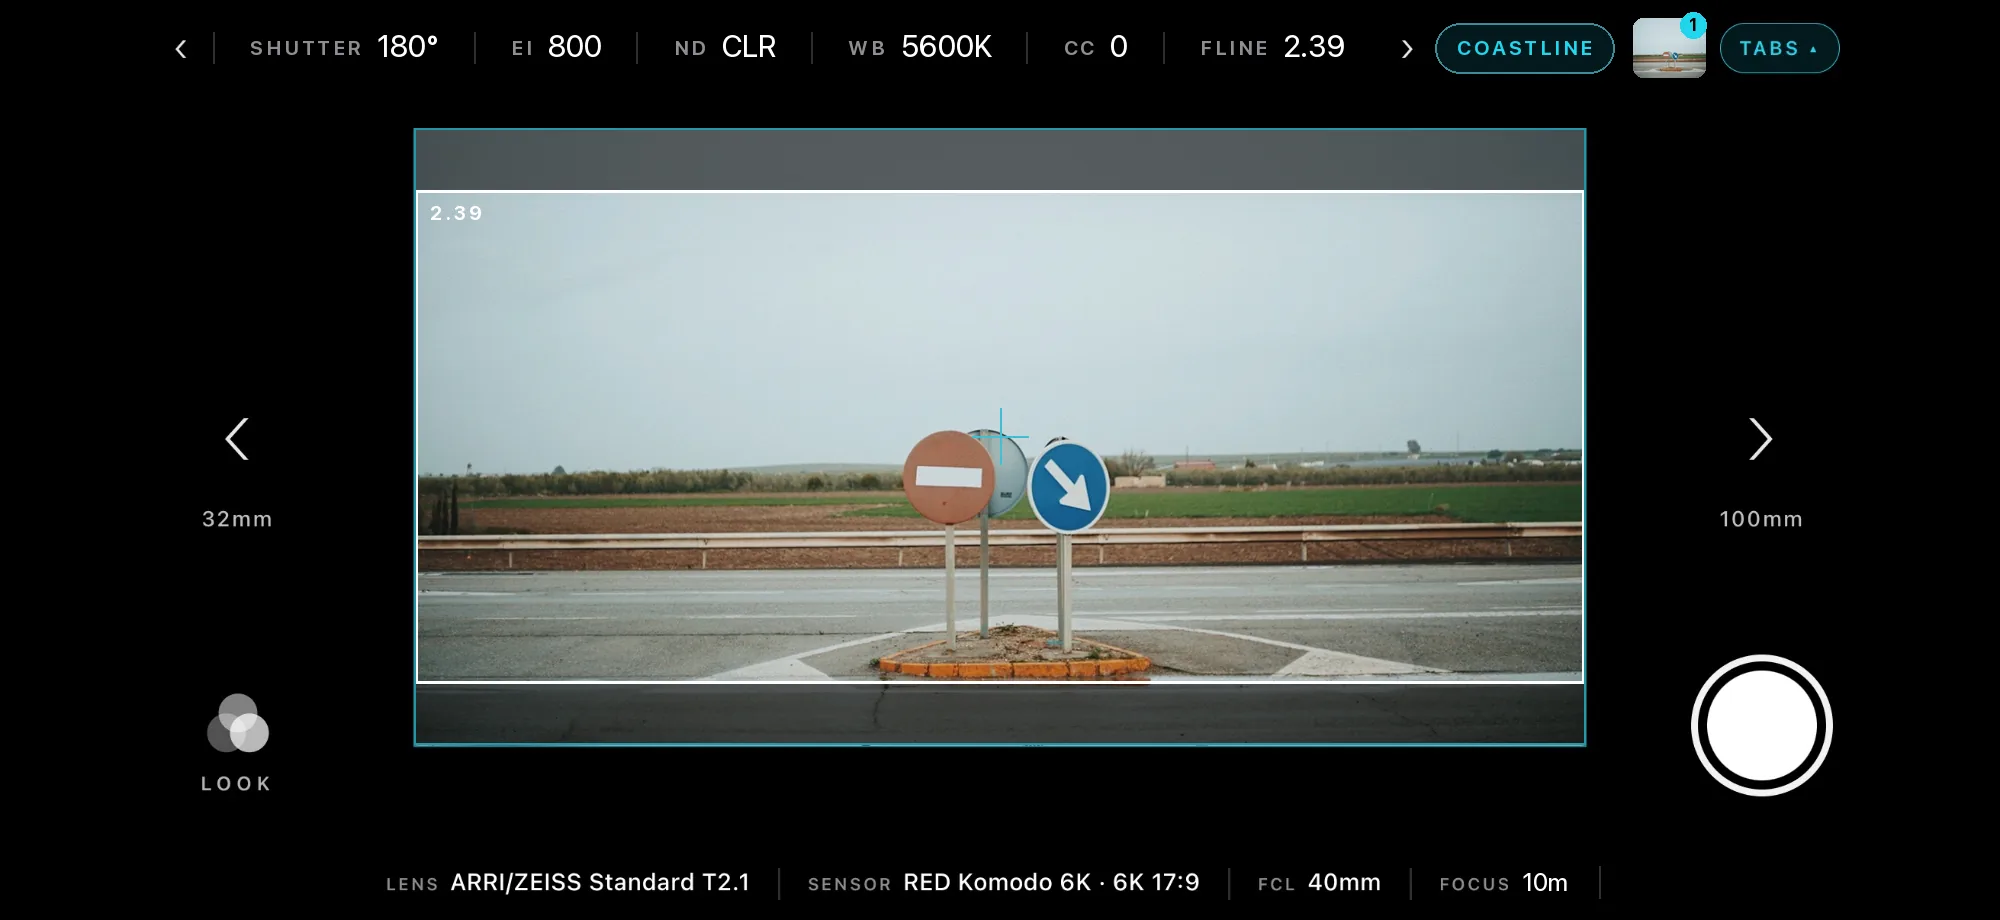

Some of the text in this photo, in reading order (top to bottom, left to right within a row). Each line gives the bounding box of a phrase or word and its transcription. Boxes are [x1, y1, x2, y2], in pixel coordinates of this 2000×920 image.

[1689, 17, 1697, 32] 1
[250, 34, 438, 58] SHUTTER 180°
[512, 34, 602, 58] EI 800
[675, 34, 776, 58] ND CLR
[848, 34, 993, 58] WB 5600K
[1064, 34, 1128, 58] CC 0
[1201, 34, 1345, 58] FLINE 2.39
[1457, 40, 1592, 56] COASTLINE
[1739, 40, 1797, 56] TABS
[202, 510, 272, 528] 32mm
[1720, 510, 1802, 528] 100mm
[201, 775, 270, 792] LOOK
[386, 872, 748, 896] LENS ARRI/ZEISS Standard T2.1
[808, 877, 891, 891] SENSOR
[904, 872, 951, 891] RED
[958, 872, 1053, 892] Komodo
[1060, 872, 1092, 892] 6K
[1113, 872, 1145, 892] 6K
[1152, 872, 1200, 892] 17:9
[1258, 872, 1381, 892] FCL 40mm
[1440, 872, 1568, 892] FOCUS 10m
